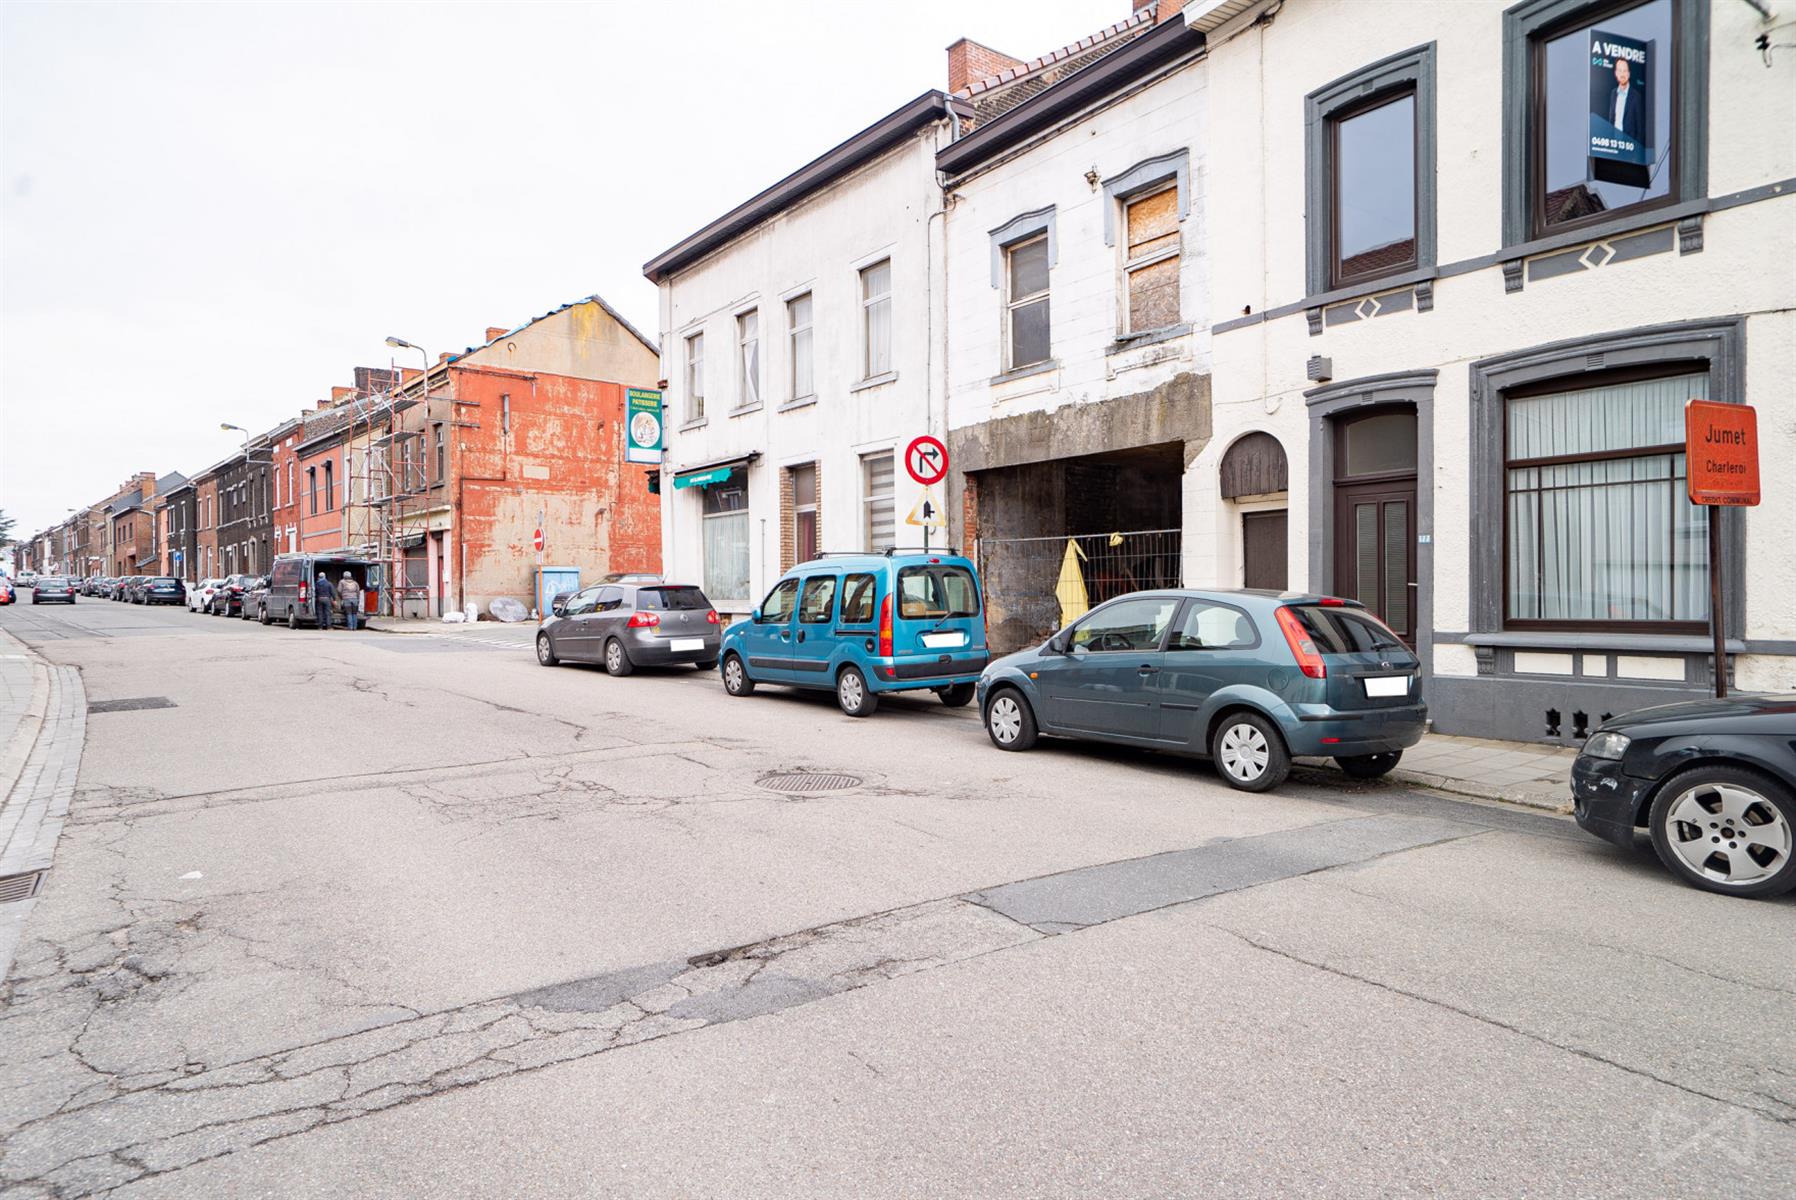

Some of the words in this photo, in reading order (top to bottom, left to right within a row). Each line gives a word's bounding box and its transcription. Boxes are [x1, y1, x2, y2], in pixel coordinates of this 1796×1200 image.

[1592, 40, 1601, 54] A
[1603, 42, 1645, 63] VENDRE
[1706, 424, 1745, 445] Jumet
[1706, 460, 1746, 473] Charleroi
